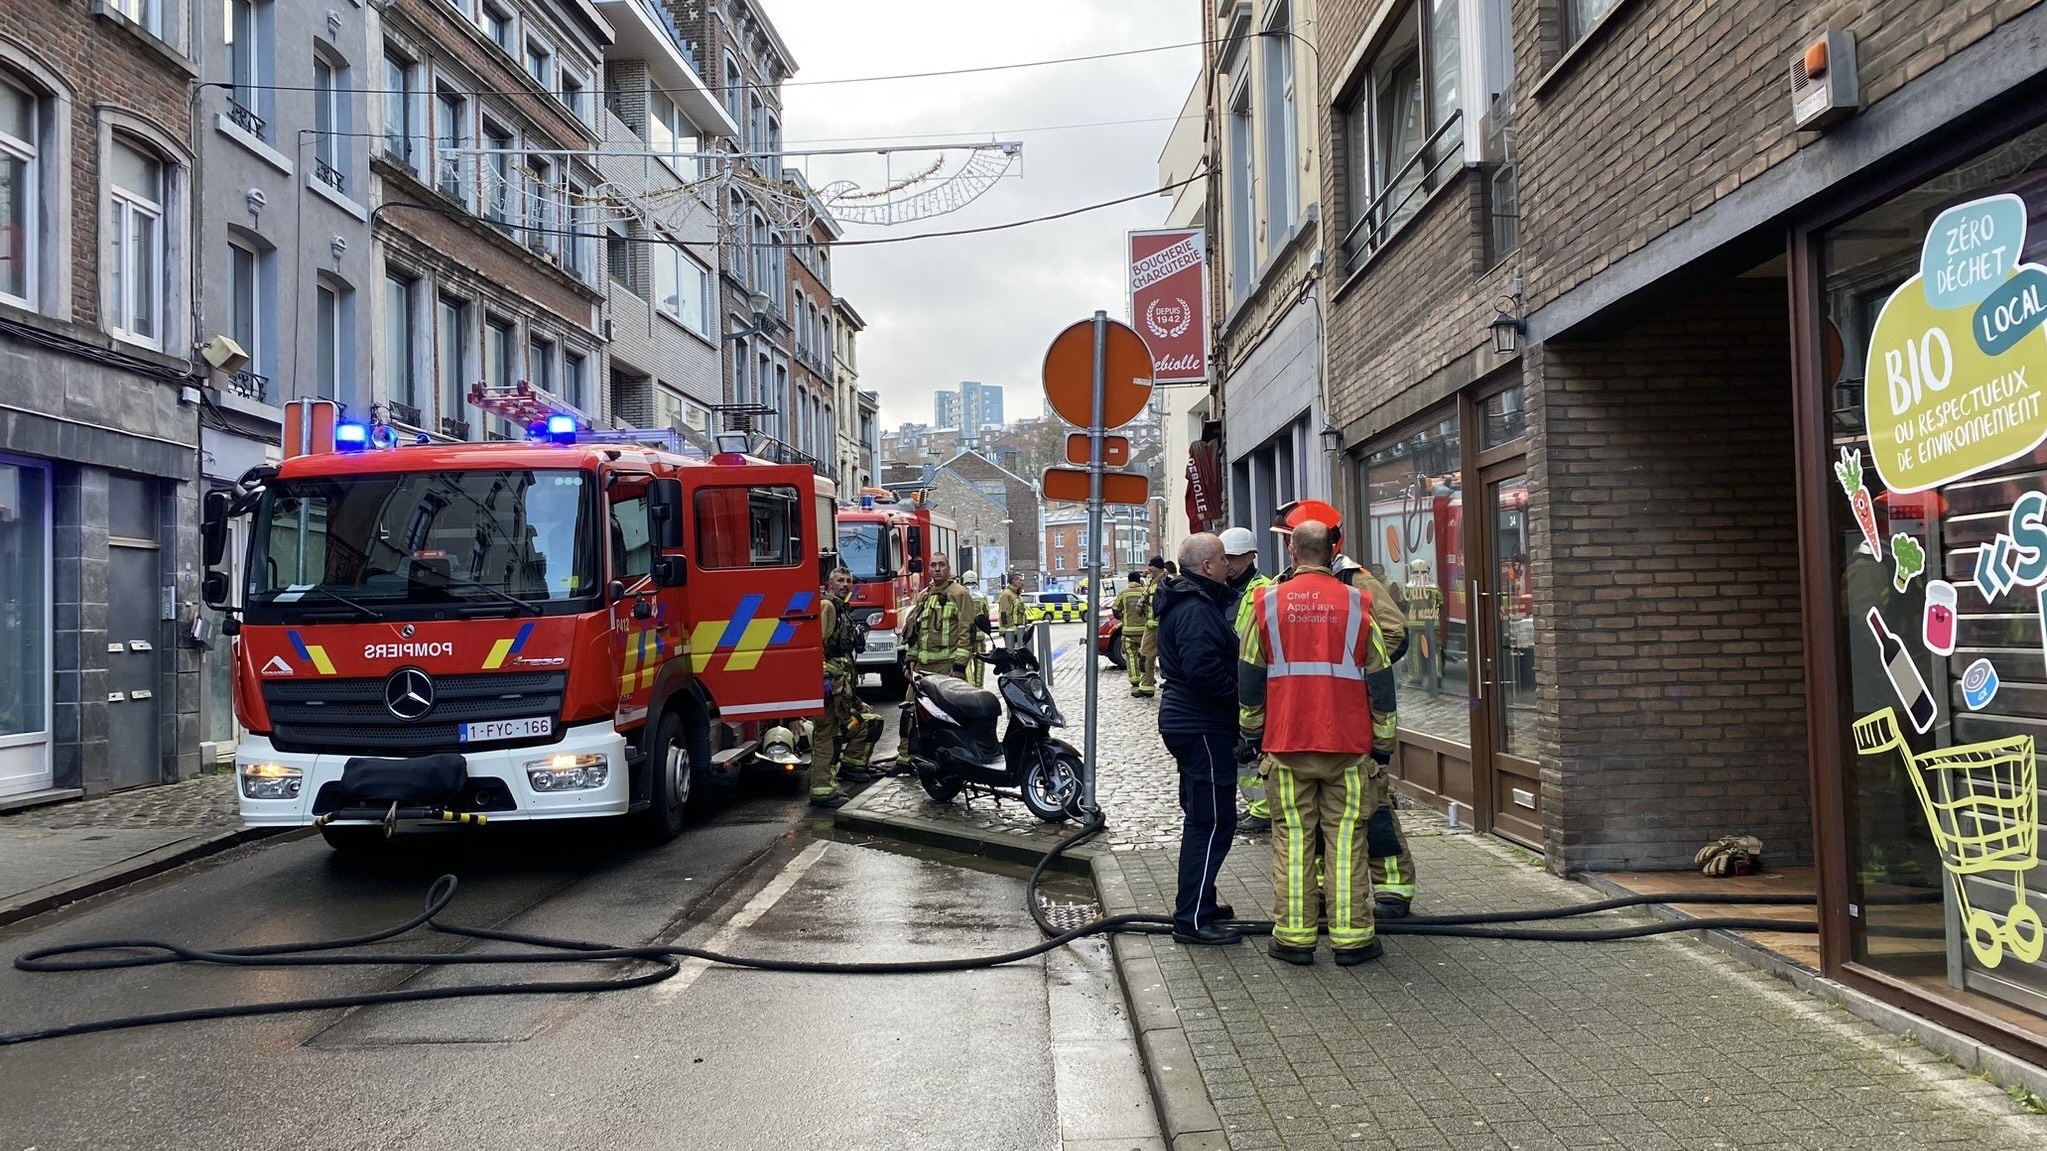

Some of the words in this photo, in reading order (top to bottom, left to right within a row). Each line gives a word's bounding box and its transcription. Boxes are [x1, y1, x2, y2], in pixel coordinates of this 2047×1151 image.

[1945, 213, 1995, 255] ZÉRO
[1132, 240, 1193, 276] BOUCHERIE
[1132, 249, 1202, 289] CHARCUTERIE
[1937, 245, 2007, 296] DÉCHET
[1156, 307, 1181, 316] DEPUIS
[1156, 315, 1181, 324] 1942
[1982, 284, 2047, 342] LOCAL
[1155, 353, 1200, 371] ebiolle
[1885, 327, 1953, 416] BIO
[1895, 419, 1914, 444] OU
[1919, 365, 2029, 438] RESPECTUEUX
[1897, 451, 1914, 474] DE
[1918, 390, 2042, 465] ENVIRONNEMENT
[1187, 457, 1207, 513] DEBIOLLE
[1509, 515, 1517, 527] 34
[1287, 591, 1310, 600] Chef
[616, 618, 630, 633] P412
[470, 720, 549, 739] 1-FYC-166
